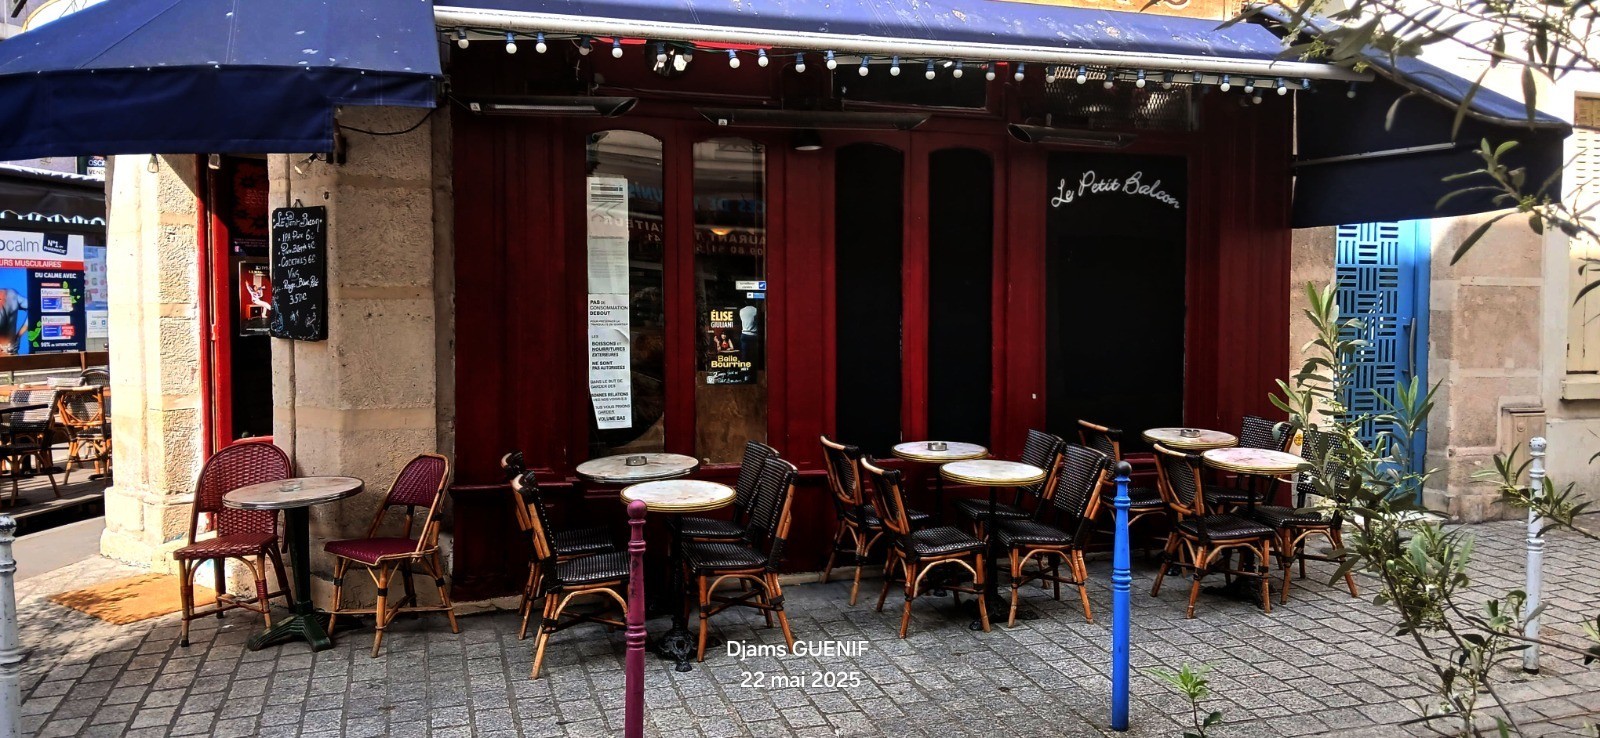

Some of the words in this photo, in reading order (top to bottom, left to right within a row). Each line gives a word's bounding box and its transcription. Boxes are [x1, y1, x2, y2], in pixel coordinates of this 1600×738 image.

[1051, 178, 1074, 208] Le
[1078, 170, 1120, 197] Petit
[1122, 171, 1180, 208] Balcon
[14, 260, 62, 268] MUSCULAIRES
[710, 310, 733, 321] ÉLISE
